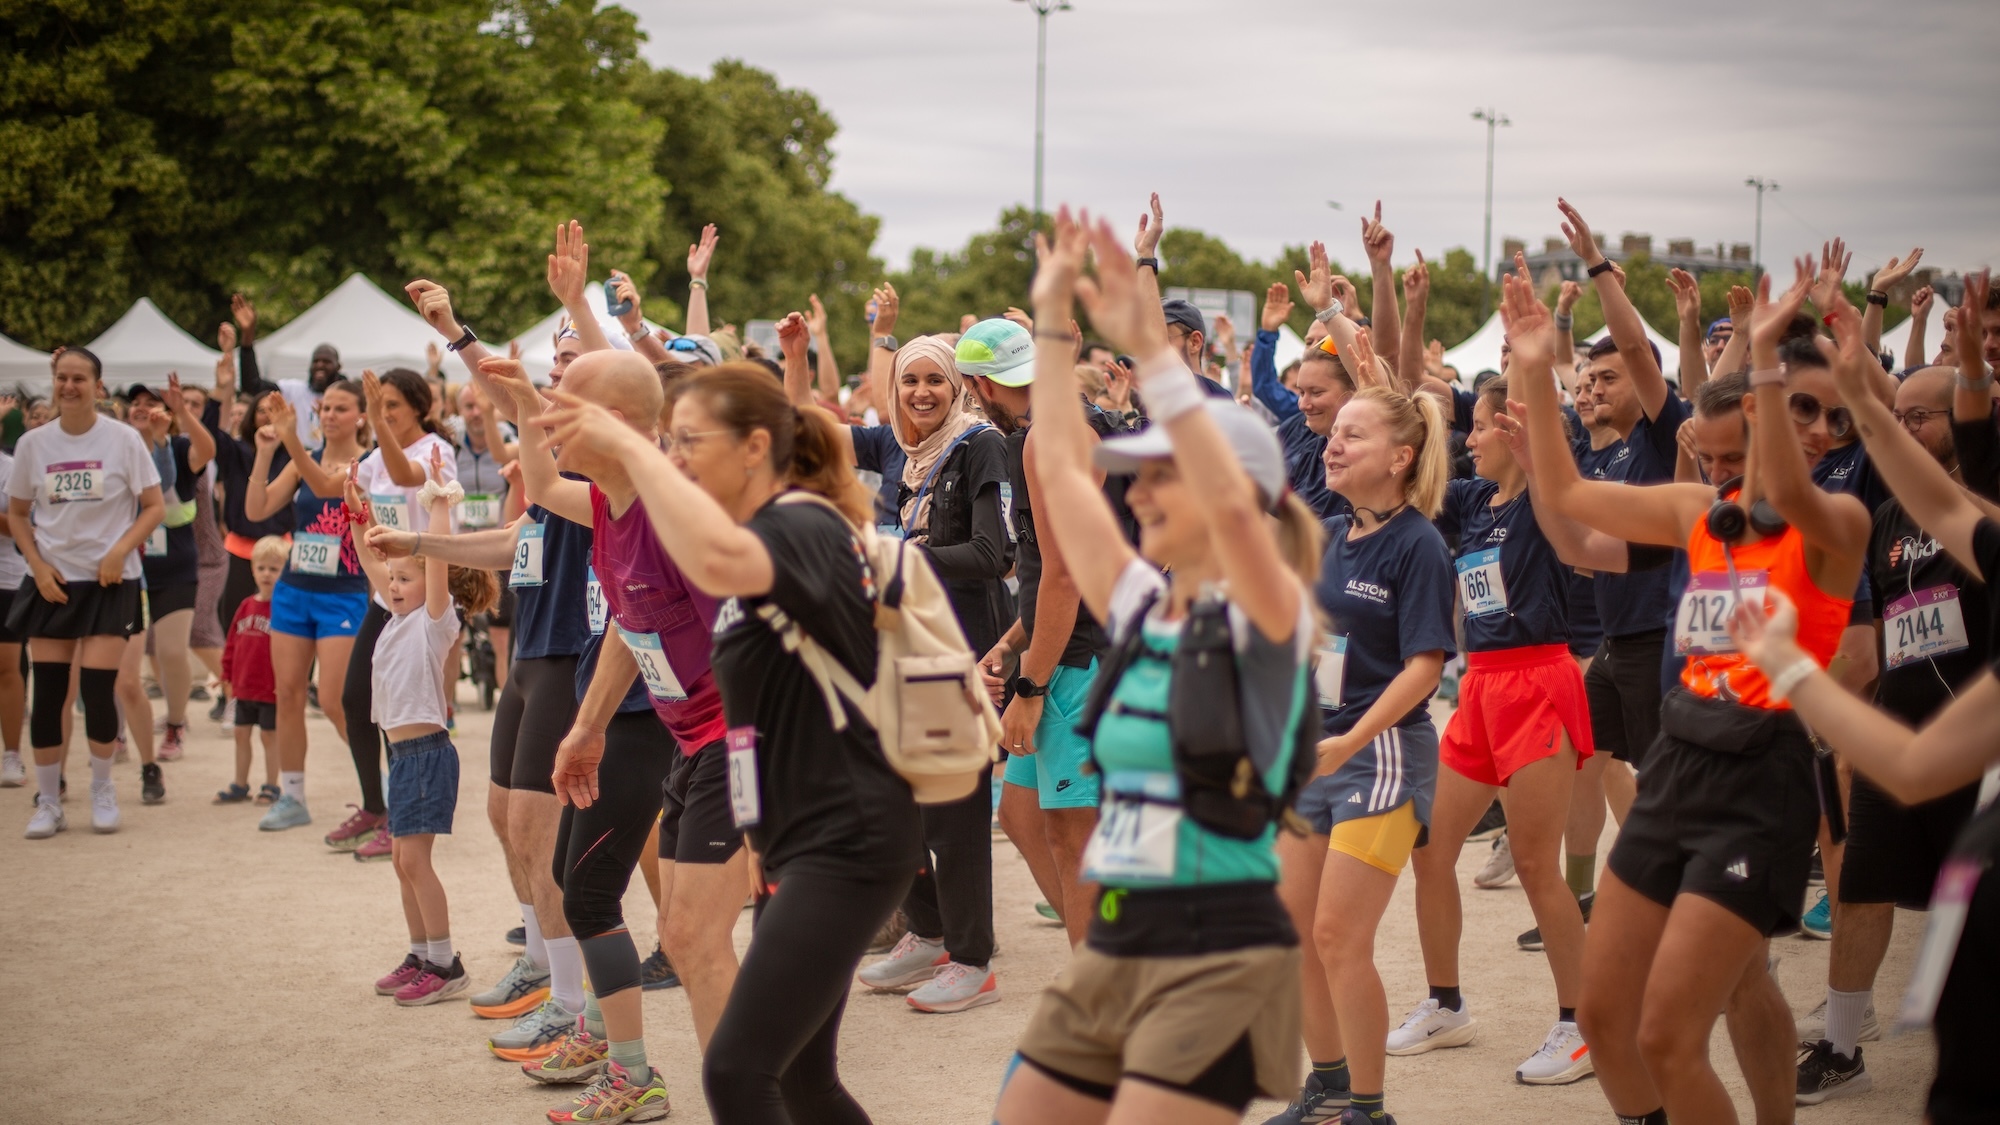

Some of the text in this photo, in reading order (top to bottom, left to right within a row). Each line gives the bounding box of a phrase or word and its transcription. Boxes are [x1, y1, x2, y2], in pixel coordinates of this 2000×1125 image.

[55, 472, 92, 492] 2326
[298, 544, 328, 564] 1520
[514, 542, 529, 569] 49
[1346, 580, 1388, 598] ALSTOM
[1464, 569, 1490, 601] 1661
[1688, 595, 1738, 632] 212
[1897, 607, 1944, 648] 2144
